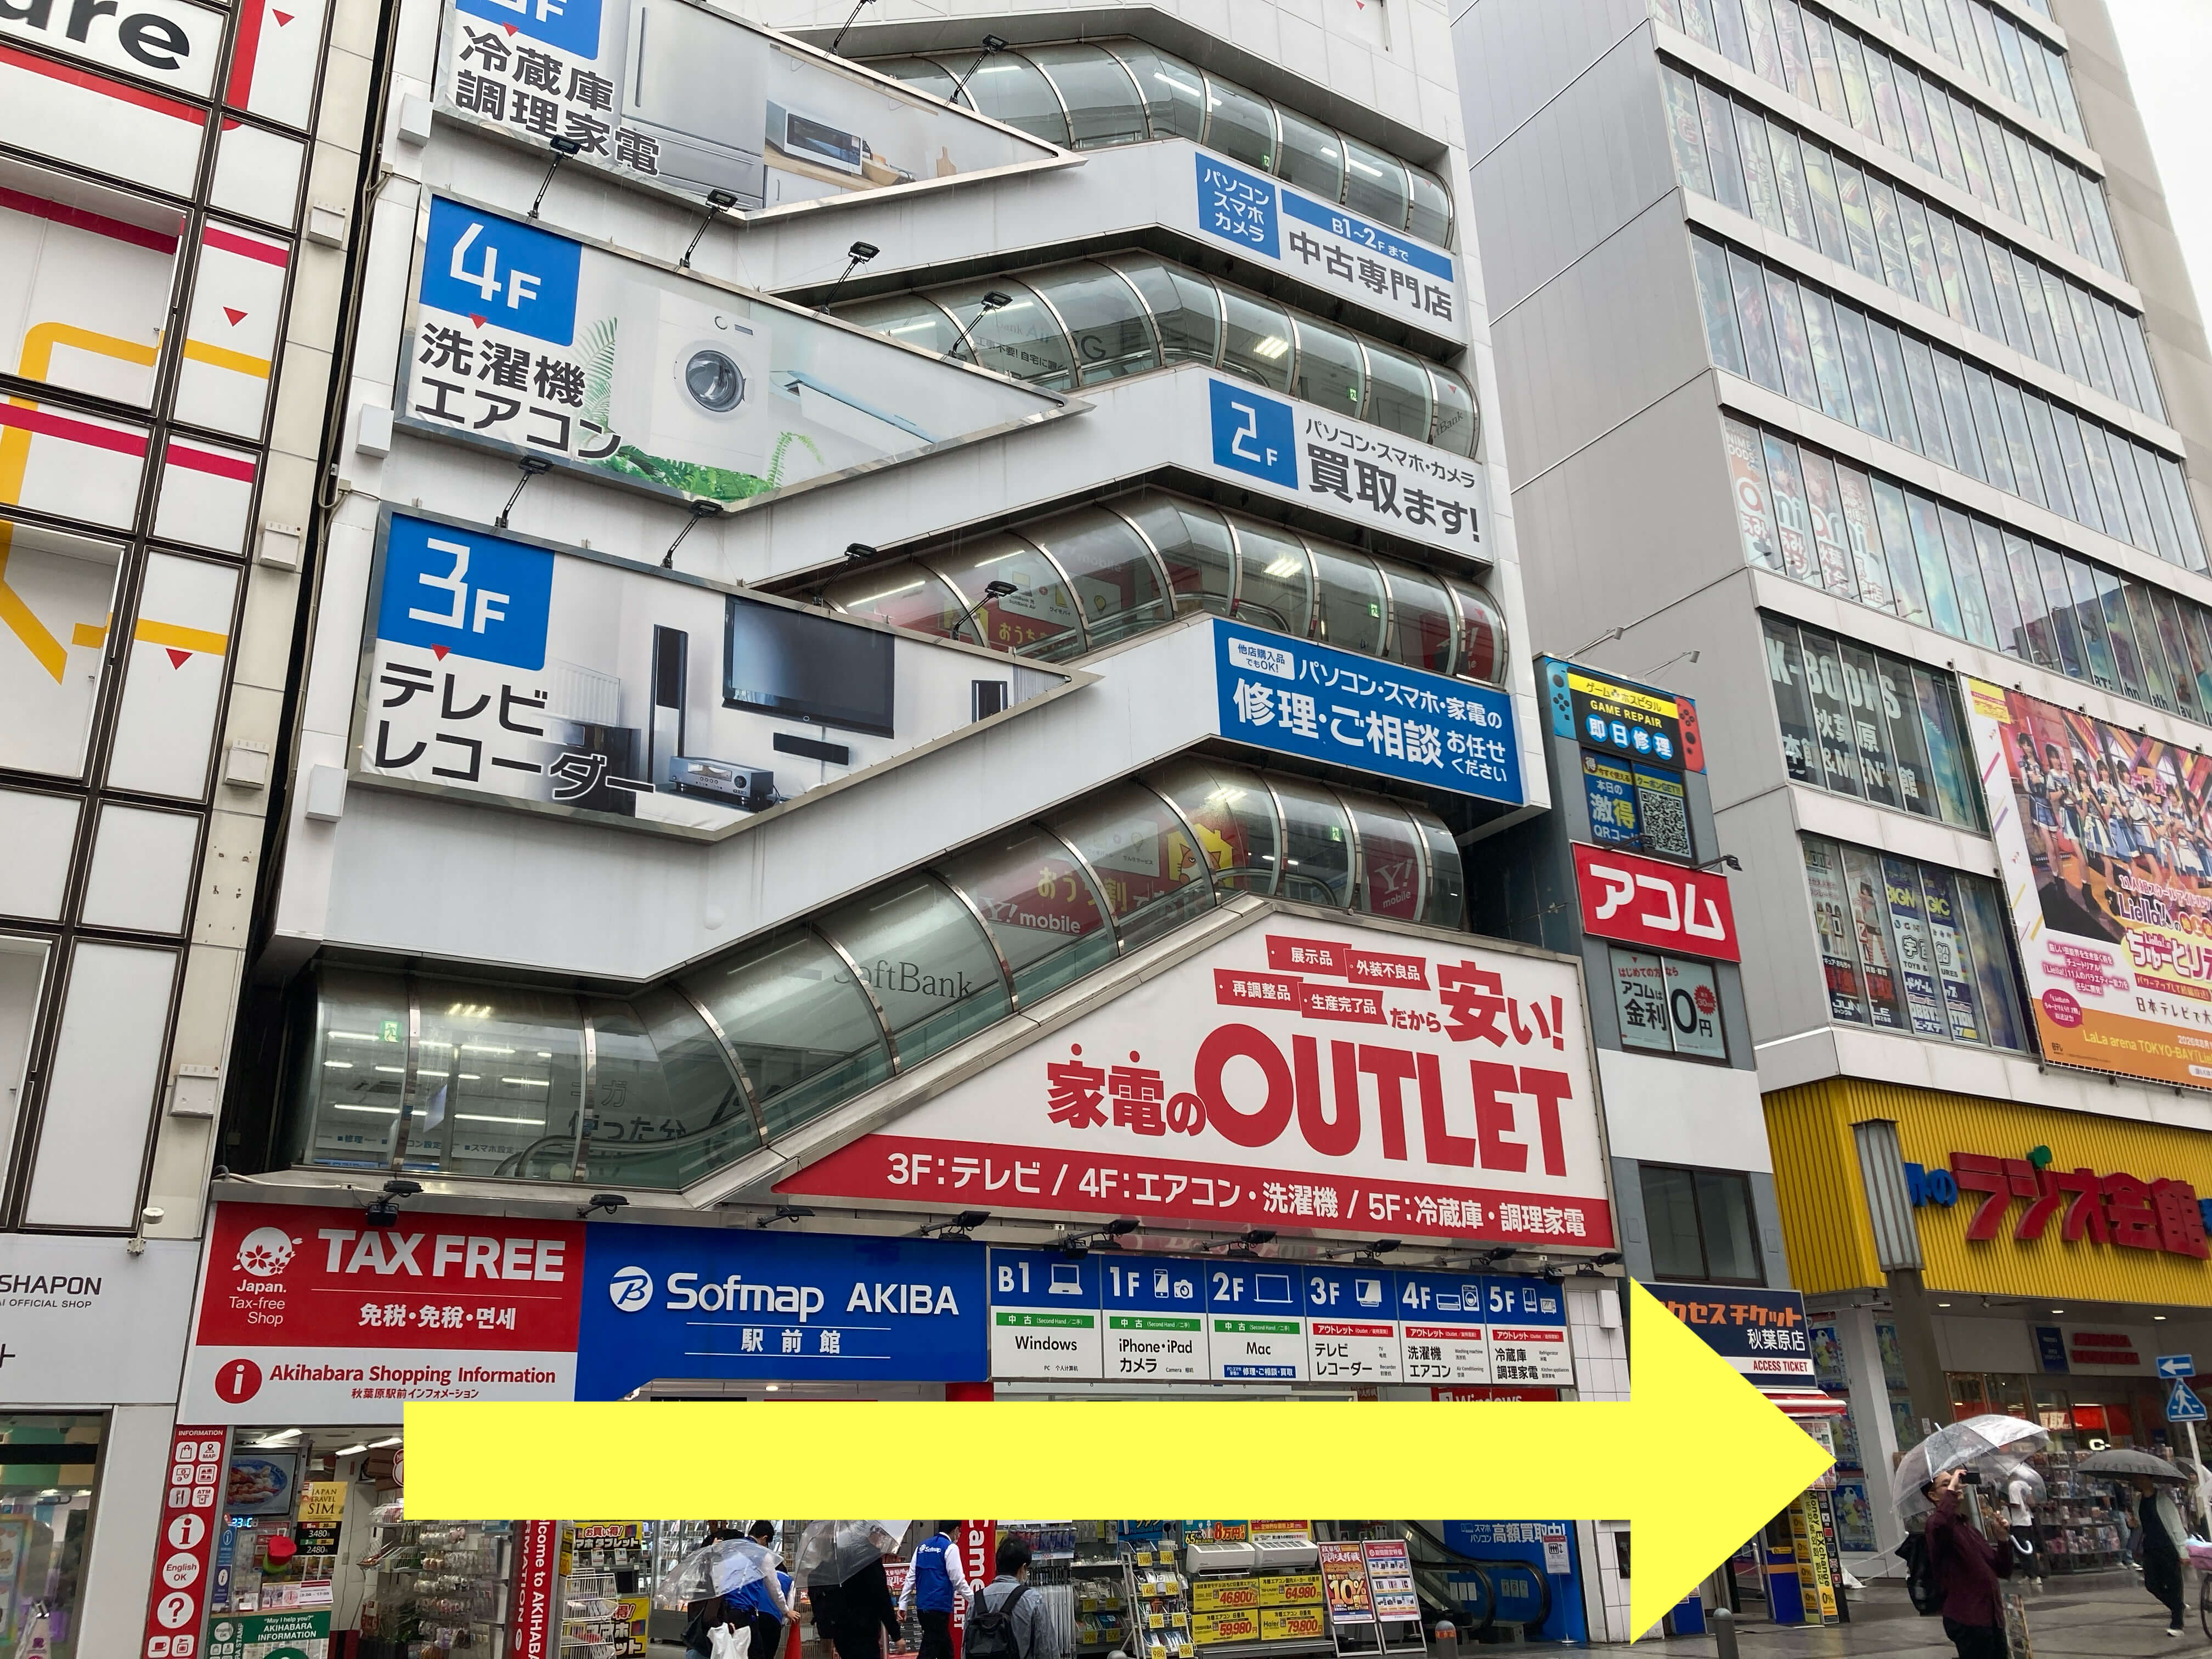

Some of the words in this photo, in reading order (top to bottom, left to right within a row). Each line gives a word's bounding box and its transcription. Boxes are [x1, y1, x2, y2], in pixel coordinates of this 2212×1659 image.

[460, 25, 613, 112] 冷蔵庫
[455, 70, 661, 176] 調理家電
[1205, 168, 1269, 205] パソコン
[1214, 191, 1264, 225] スマホ
[1215, 212, 1264, 242] カメラ
[450, 223, 541, 309] 4F
[1289, 230, 1452, 322] 中古専門店
[419, 323, 585, 408] 洗濯機
[415, 376, 622, 459] エアコン
[1231, 401, 1278, 466] 2F
[1306, 419, 1475, 488] パソコン・スマホ・カメラ
[1307, 443, 1480, 542] 買取ます!
[409, 538, 510, 634] 3F
[1238, 644, 1285, 664] 他店購入品
[1246, 657, 1279, 674] でもOK!
[380, 662, 548, 736] テレビ
[1299, 659, 1502, 729] パソコン・スマホ・家電の
[1233, 679, 1444, 769] 修理・ご相談
[1589, 699, 1621, 717] GAME
[1624, 710, 1663, 729] REPAIR
[1446, 730, 1505, 763] お任せ
[1587, 716, 1674, 759] 即日修理
[375, 720, 654, 799] レコーダー
[1452, 759, 1507, 782] ください
[1597, 780, 1623, 795] 本日の
[1590, 792, 1635, 829] 激得
[1383, 890, 1411, 909] mobile
[1590, 864, 1725, 941] アコム
[1020, 912, 1080, 933] mobile
[1291, 947, 1333, 967] 展示品
[1356, 960, 1420, 982] 外装不良品
[1232, 979, 1291, 1001] 再調整品
[1311, 992, 1378, 1015] 生産完了品
[1437, 960, 1564, 1051] 安い!
[1390, 1008, 1441, 1033] だから
[887, 1153, 1040, 1195] 3F:テレビ
[317, 1228, 426, 1276] TAX
[432, 1234, 565, 1282] FREE
[236, 1279, 286, 1295] Japan.
[998, 1262, 1029, 1293] B1
[1110, 1266, 1139, 1297] 1F
[1212, 1272, 1243, 1301] 2F
[667, 1273, 825, 1323] Sofmap
[846, 1283, 960, 1316] AKIBA
[1310, 1277, 1340, 1305] 3F
[1402, 1282, 1430, 1310] 4F
[1489, 1286, 1514, 1313] 5F
[9, 1299, 57, 1307] OFFICIAL
[61, 1300, 92, 1308] SHOP
[229, 1296, 285, 1310] Tax-free
[247, 1312, 283, 1327] Shop
[1318, 1325, 1353, 1334] アウトレット
[741, 1328, 841, 1354] 駅前館
[1015, 1336, 1077, 1351] Windows
[1410, 1328, 1443, 1337] アウトレット
[1497, 1331, 1528, 1340] アウトレット
[1747, 1329, 1805, 1352] 秋葉原店
[1246, 1342, 1271, 1355] Mac
[1315, 1343, 1348, 1357] テレビ
[1408, 1346, 1442, 1361] 洗濯機
[1494, 1348, 1527, 1362] 冷蔵庫
[269, 1364, 363, 1383] Akihabara
[369, 1365, 452, 1386] Shopping
[459, 1367, 556, 1384] Information
[1120, 1358, 1157, 1373] カメラ
[1317, 1361, 1372, 1376] レコーダー
[1410, 1364, 1451, 1378] エアコン
[1497, 1365, 1538, 1380] 調理家電
[1753, 1359, 1781, 1372] ACCESS
[1783, 1361, 1808, 1373] TICKET
[352, 1388, 479, 1400] 秋葉原駅前インフォメーション
[312, 1488, 338, 1496] JAPAN
[308, 1503, 336, 1515] SIM
[1470, 1534, 1491, 1543] パソコン
[1475, 1523, 1491, 1533] スマホ
[535, 1520, 550, 1567] lcome
[166, 1563, 197, 1573] English
[173, 1574, 187, 1582] OK
[533, 1572, 546, 1587] to
[1822, 1592, 1834, 1604] 0%
[257, 1630, 317, 1641] INFORMATION
[263, 1622, 313, 1632] AKIHABARA
